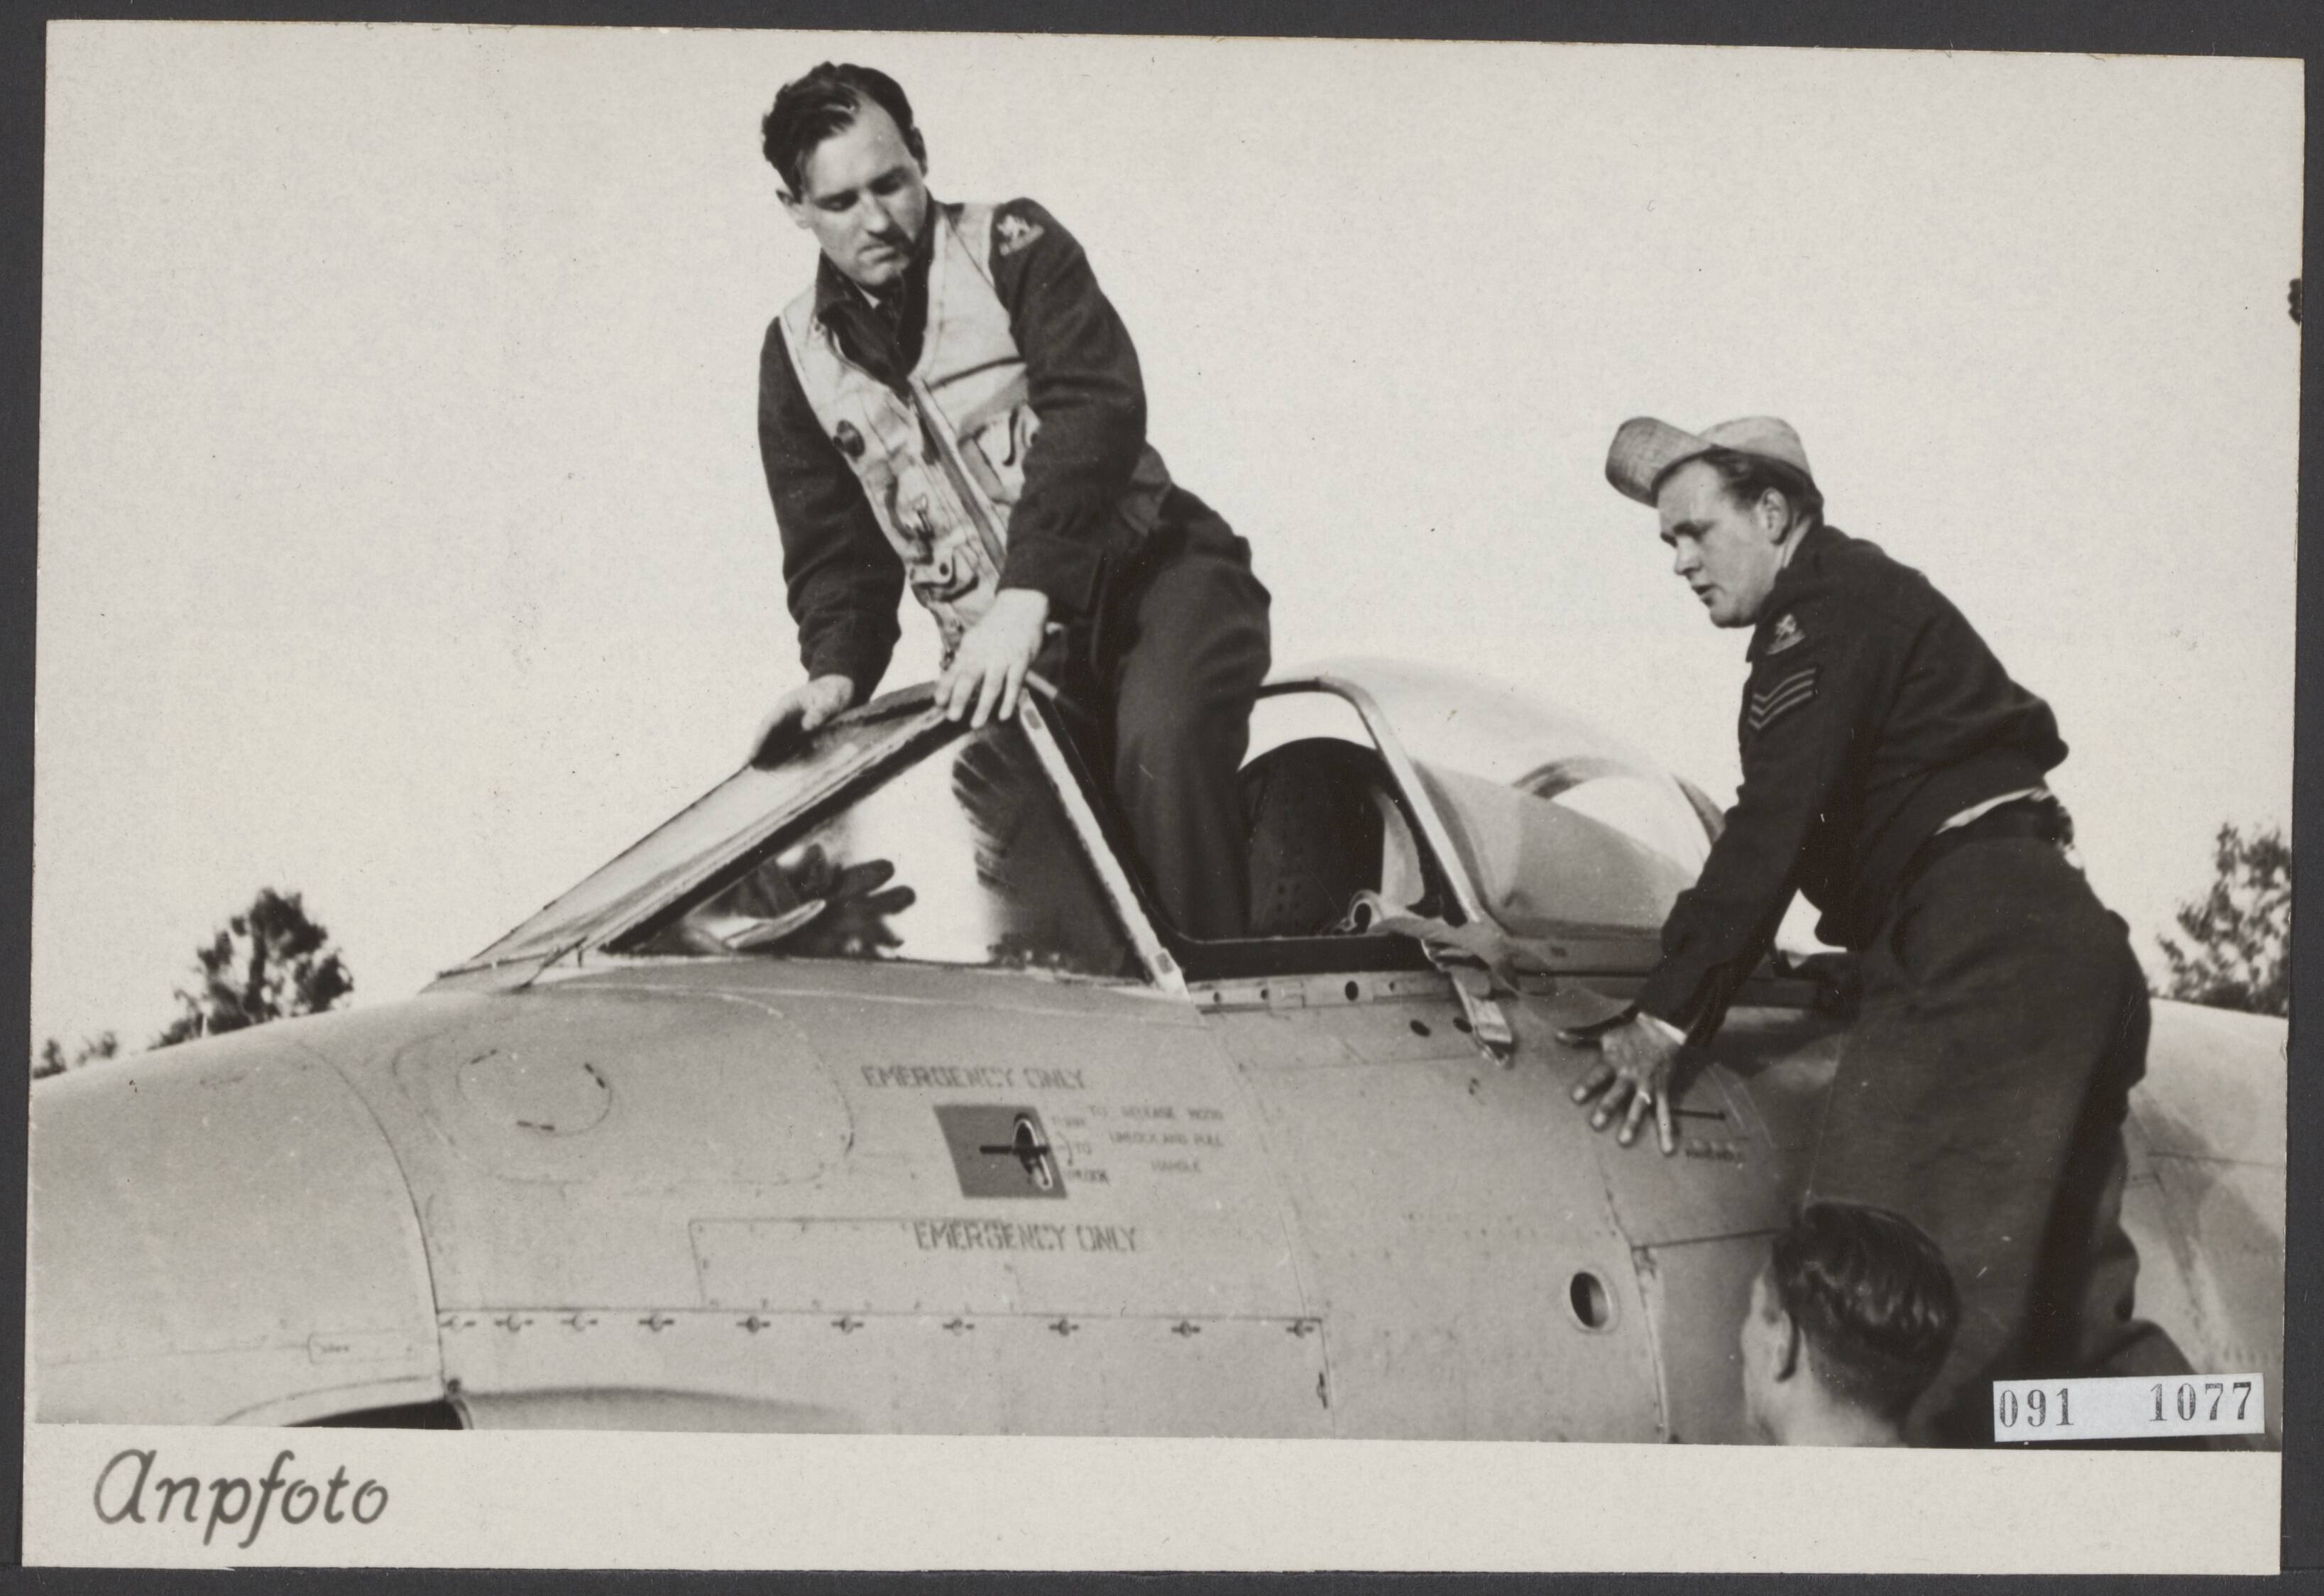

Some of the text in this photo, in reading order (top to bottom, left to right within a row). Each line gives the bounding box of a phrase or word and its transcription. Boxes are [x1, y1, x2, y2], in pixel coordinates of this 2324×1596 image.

[861, 1066, 1085, 1089] EMERGENCY ONLY
[913, 1221, 1136, 1252] EMERGENCY ONLY
